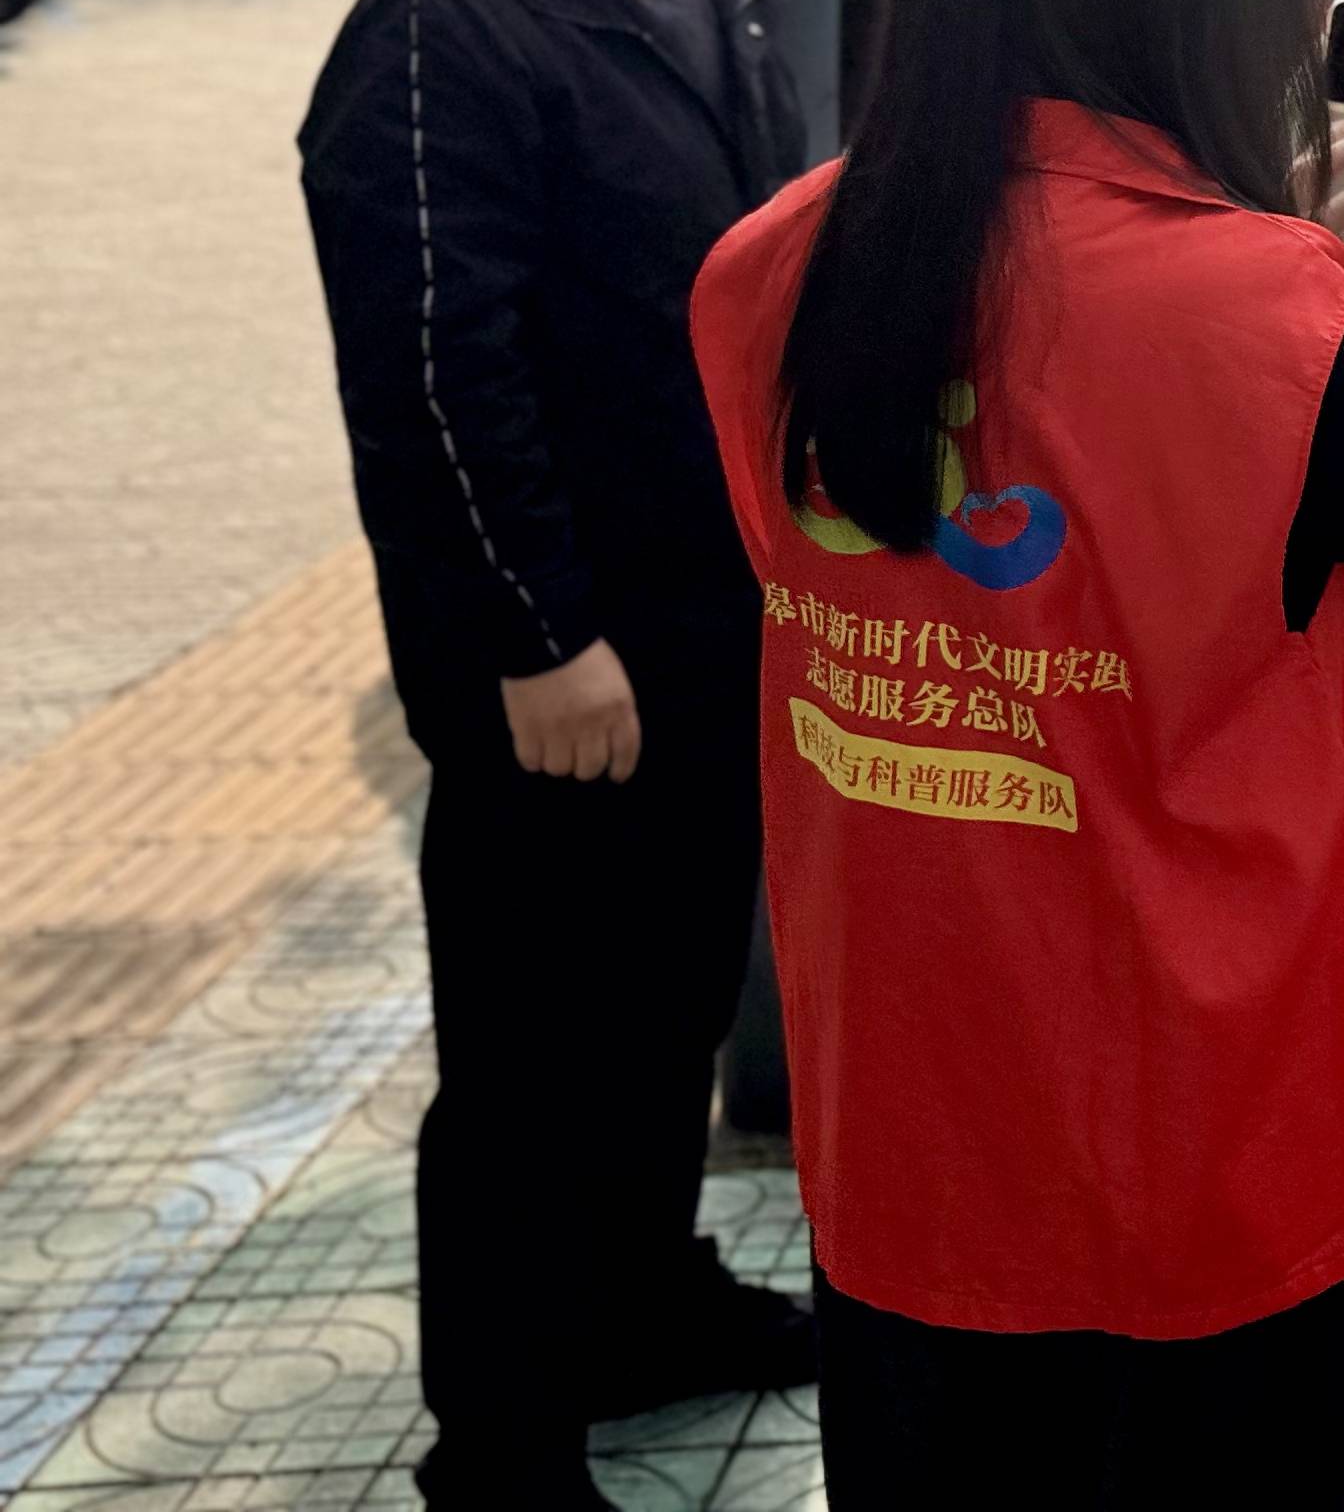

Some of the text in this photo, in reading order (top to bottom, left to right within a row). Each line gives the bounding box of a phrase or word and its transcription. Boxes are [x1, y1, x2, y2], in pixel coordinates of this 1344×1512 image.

[805, 646, 1047, 748] 志愿服务总队
[800, 715, 1075, 818] 科技与科普服务队
